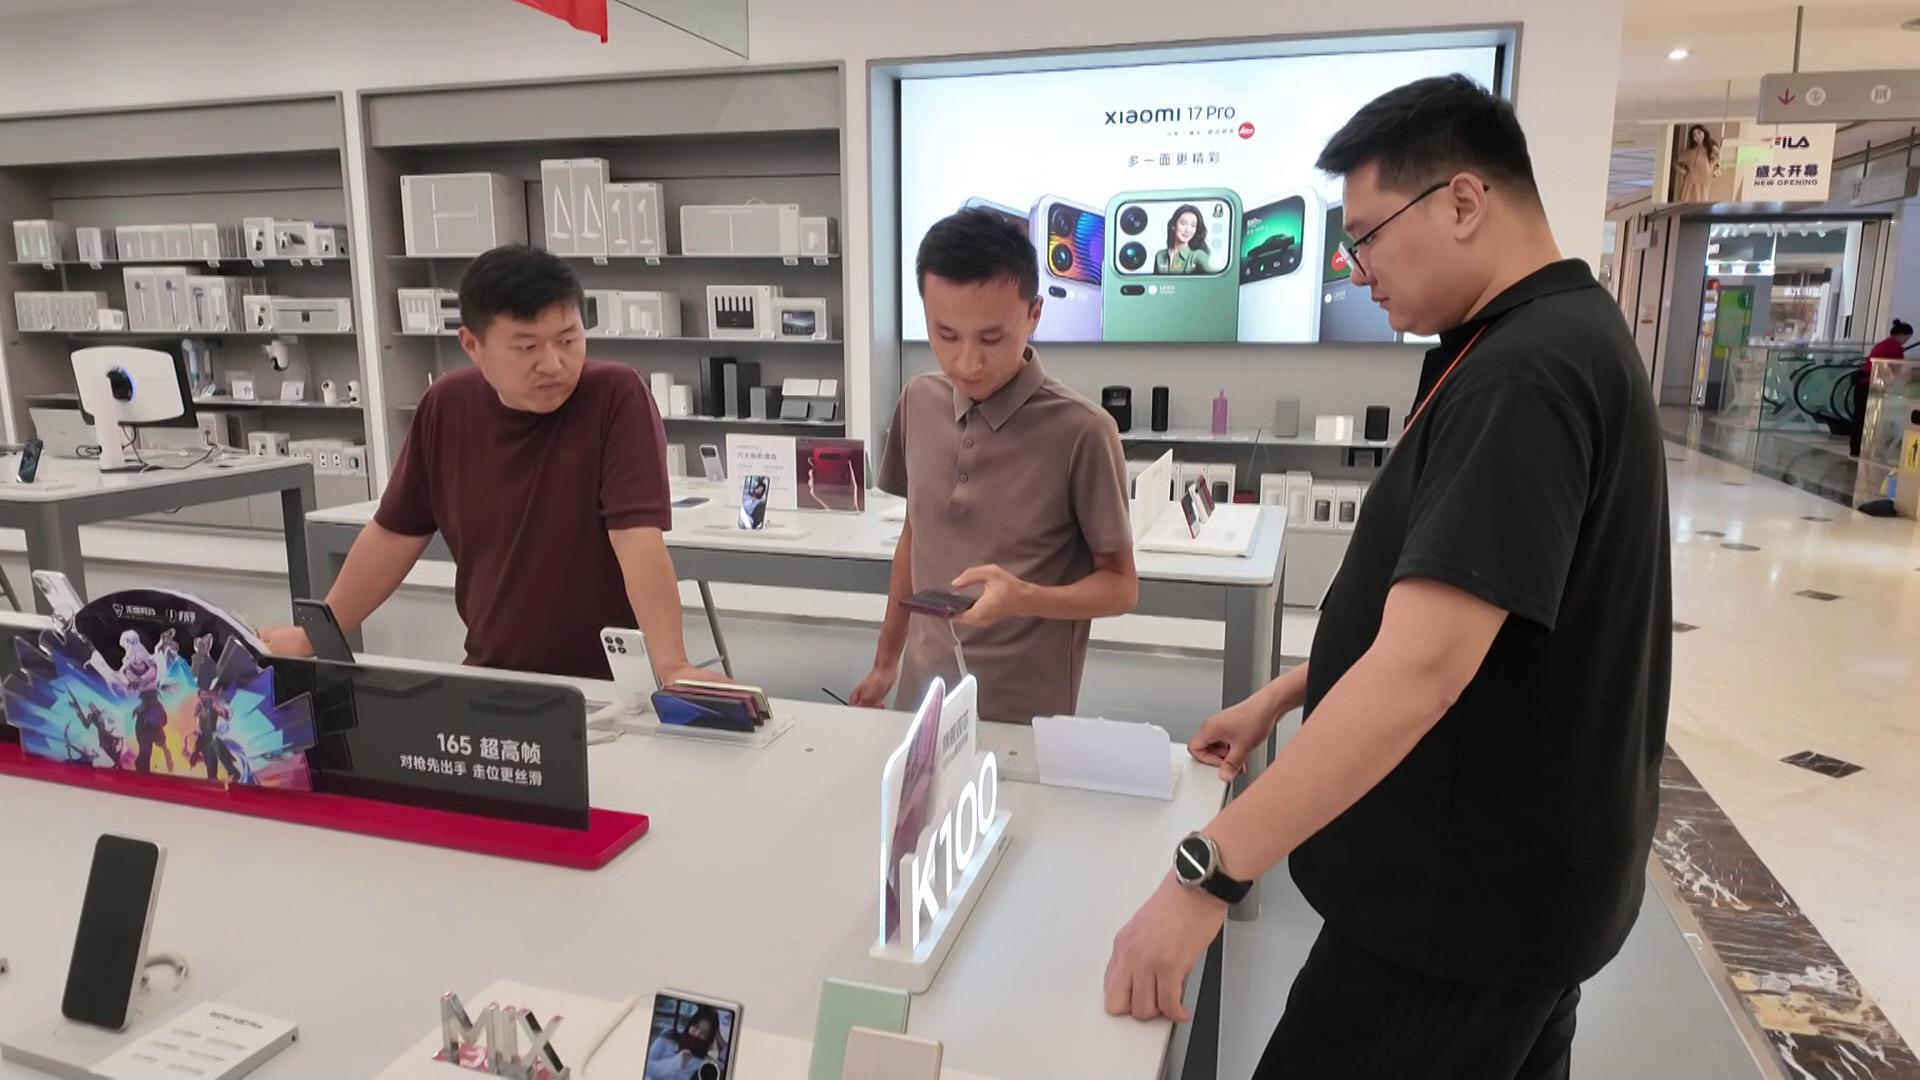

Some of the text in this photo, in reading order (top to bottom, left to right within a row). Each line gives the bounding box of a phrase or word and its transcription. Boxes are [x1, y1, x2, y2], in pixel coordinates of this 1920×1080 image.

[1104, 105, 1236, 125] xiaomi 17 Pro
[1127, 151, 1221, 168] 多一面更精彩
[1756, 164, 1818, 178] 盛大开幕
[1754, 178, 1819, 187] NEW OPENING
[436, 732, 542, 765] 165 超高帧
[399, 753, 543, 787] 对枪先出手 走位更丝滑
[908, 751, 999, 951] K100
